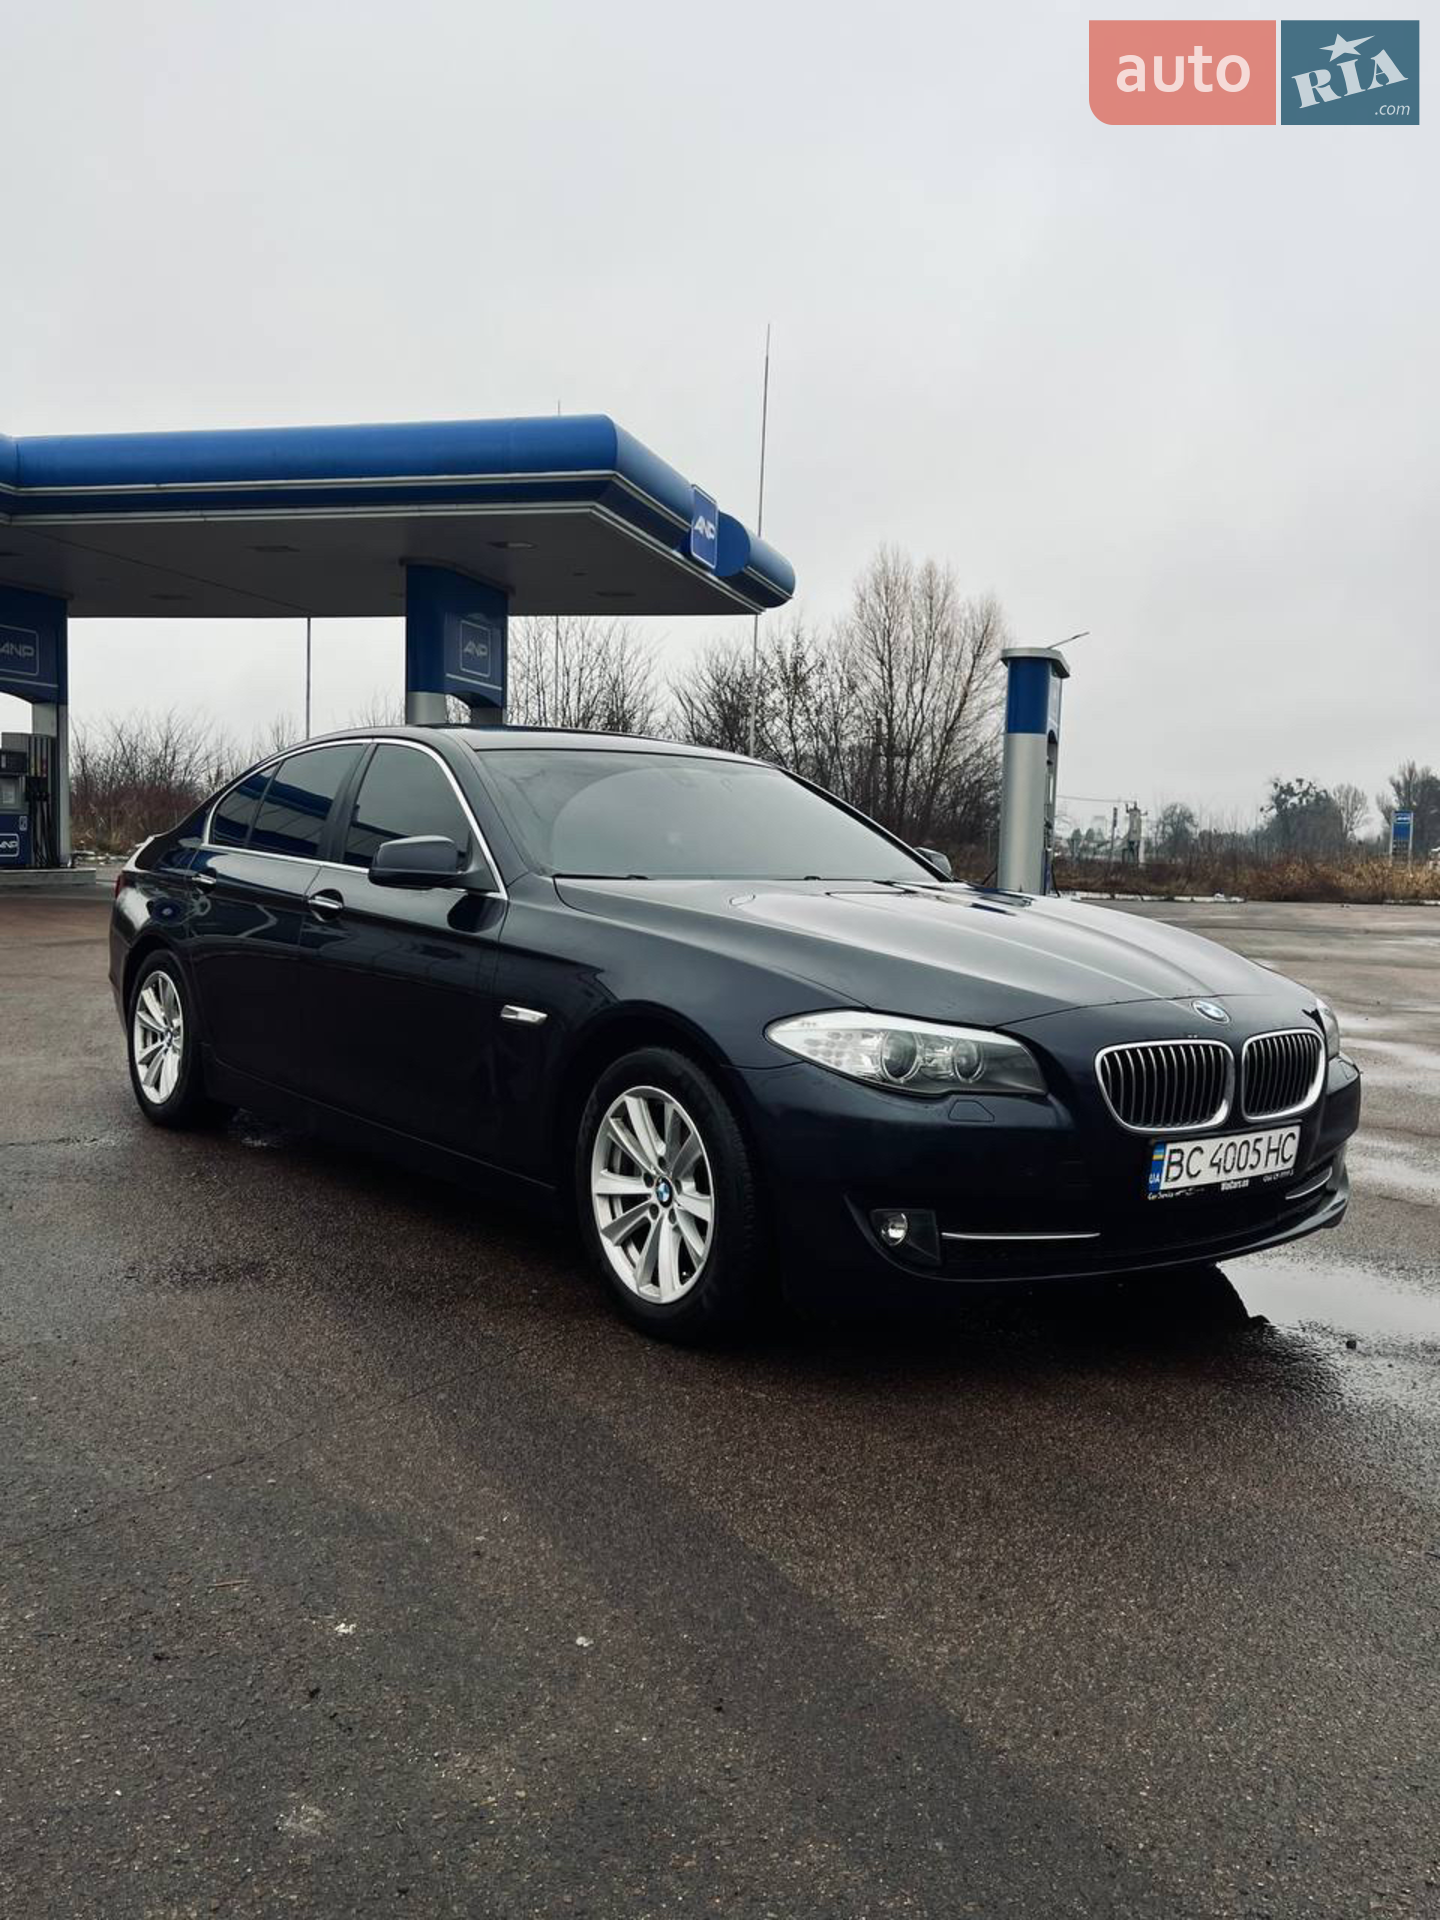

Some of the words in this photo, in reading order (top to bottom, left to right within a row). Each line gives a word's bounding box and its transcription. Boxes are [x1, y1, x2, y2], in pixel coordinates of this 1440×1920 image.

[1165, 1146, 1204, 1183] BC
[1210, 1138, 1263, 1175] 4005
[1265, 1132, 1296, 1168] HC
